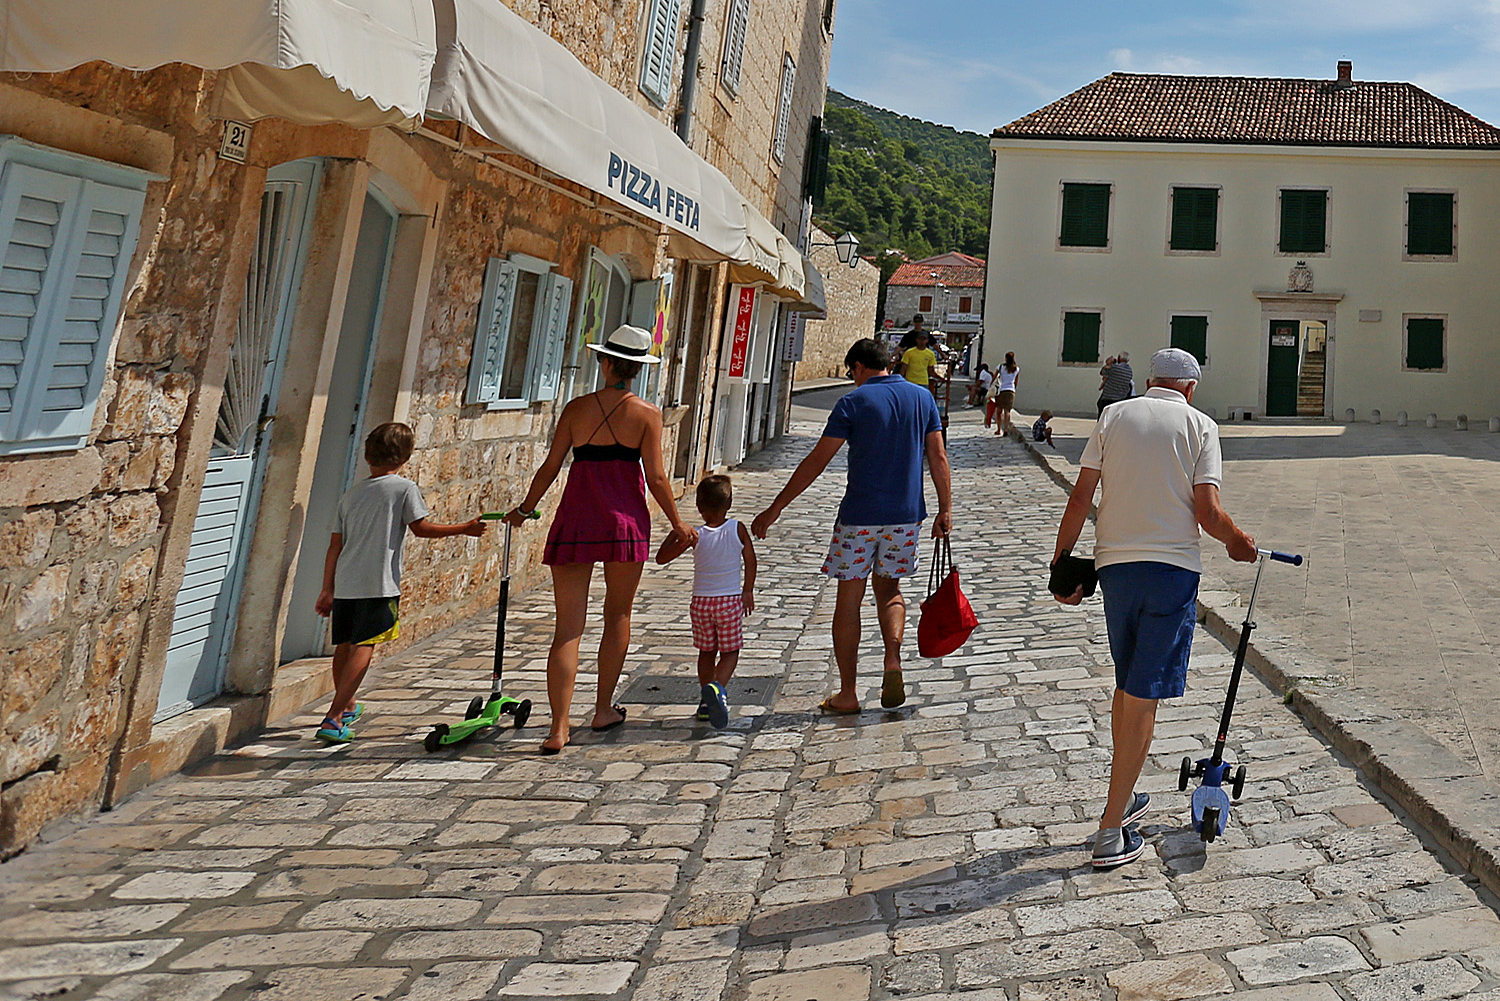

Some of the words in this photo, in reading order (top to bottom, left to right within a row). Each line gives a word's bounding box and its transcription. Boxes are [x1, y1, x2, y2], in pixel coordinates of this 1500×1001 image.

[230, 126, 246, 147] 21
[607, 151, 662, 214] PIZZA
[665, 186, 700, 232] FETA
